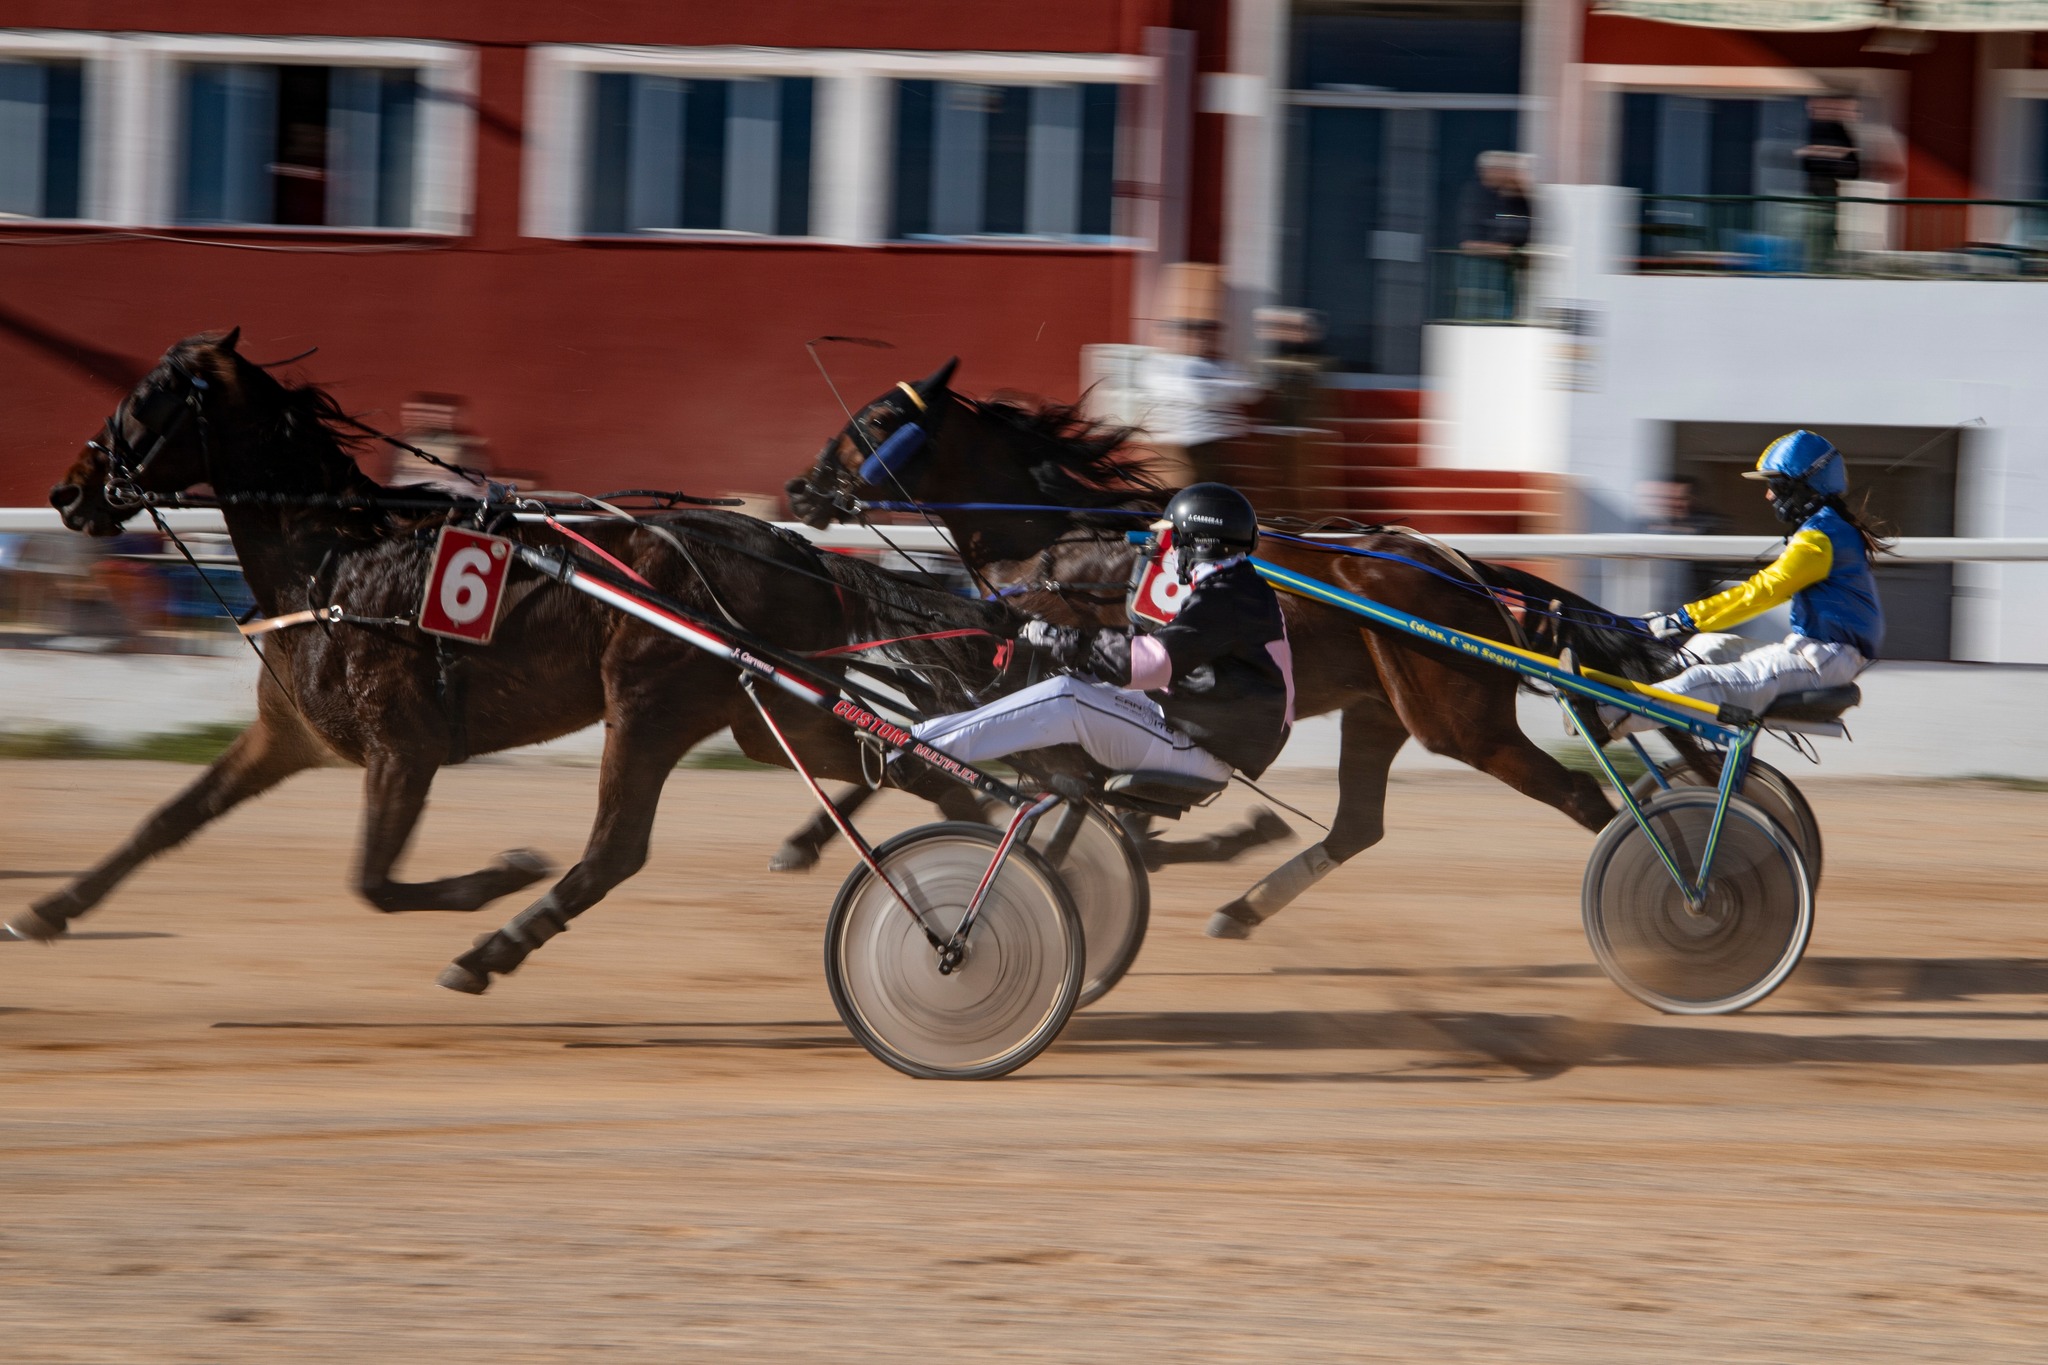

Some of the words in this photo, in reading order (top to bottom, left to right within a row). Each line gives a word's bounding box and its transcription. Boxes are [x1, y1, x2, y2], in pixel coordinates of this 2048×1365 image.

[440, 546, 492, 624] 6
[832, 699, 912, 748] CUSTOM
[913, 743, 980, 784] MULTIFLEX
